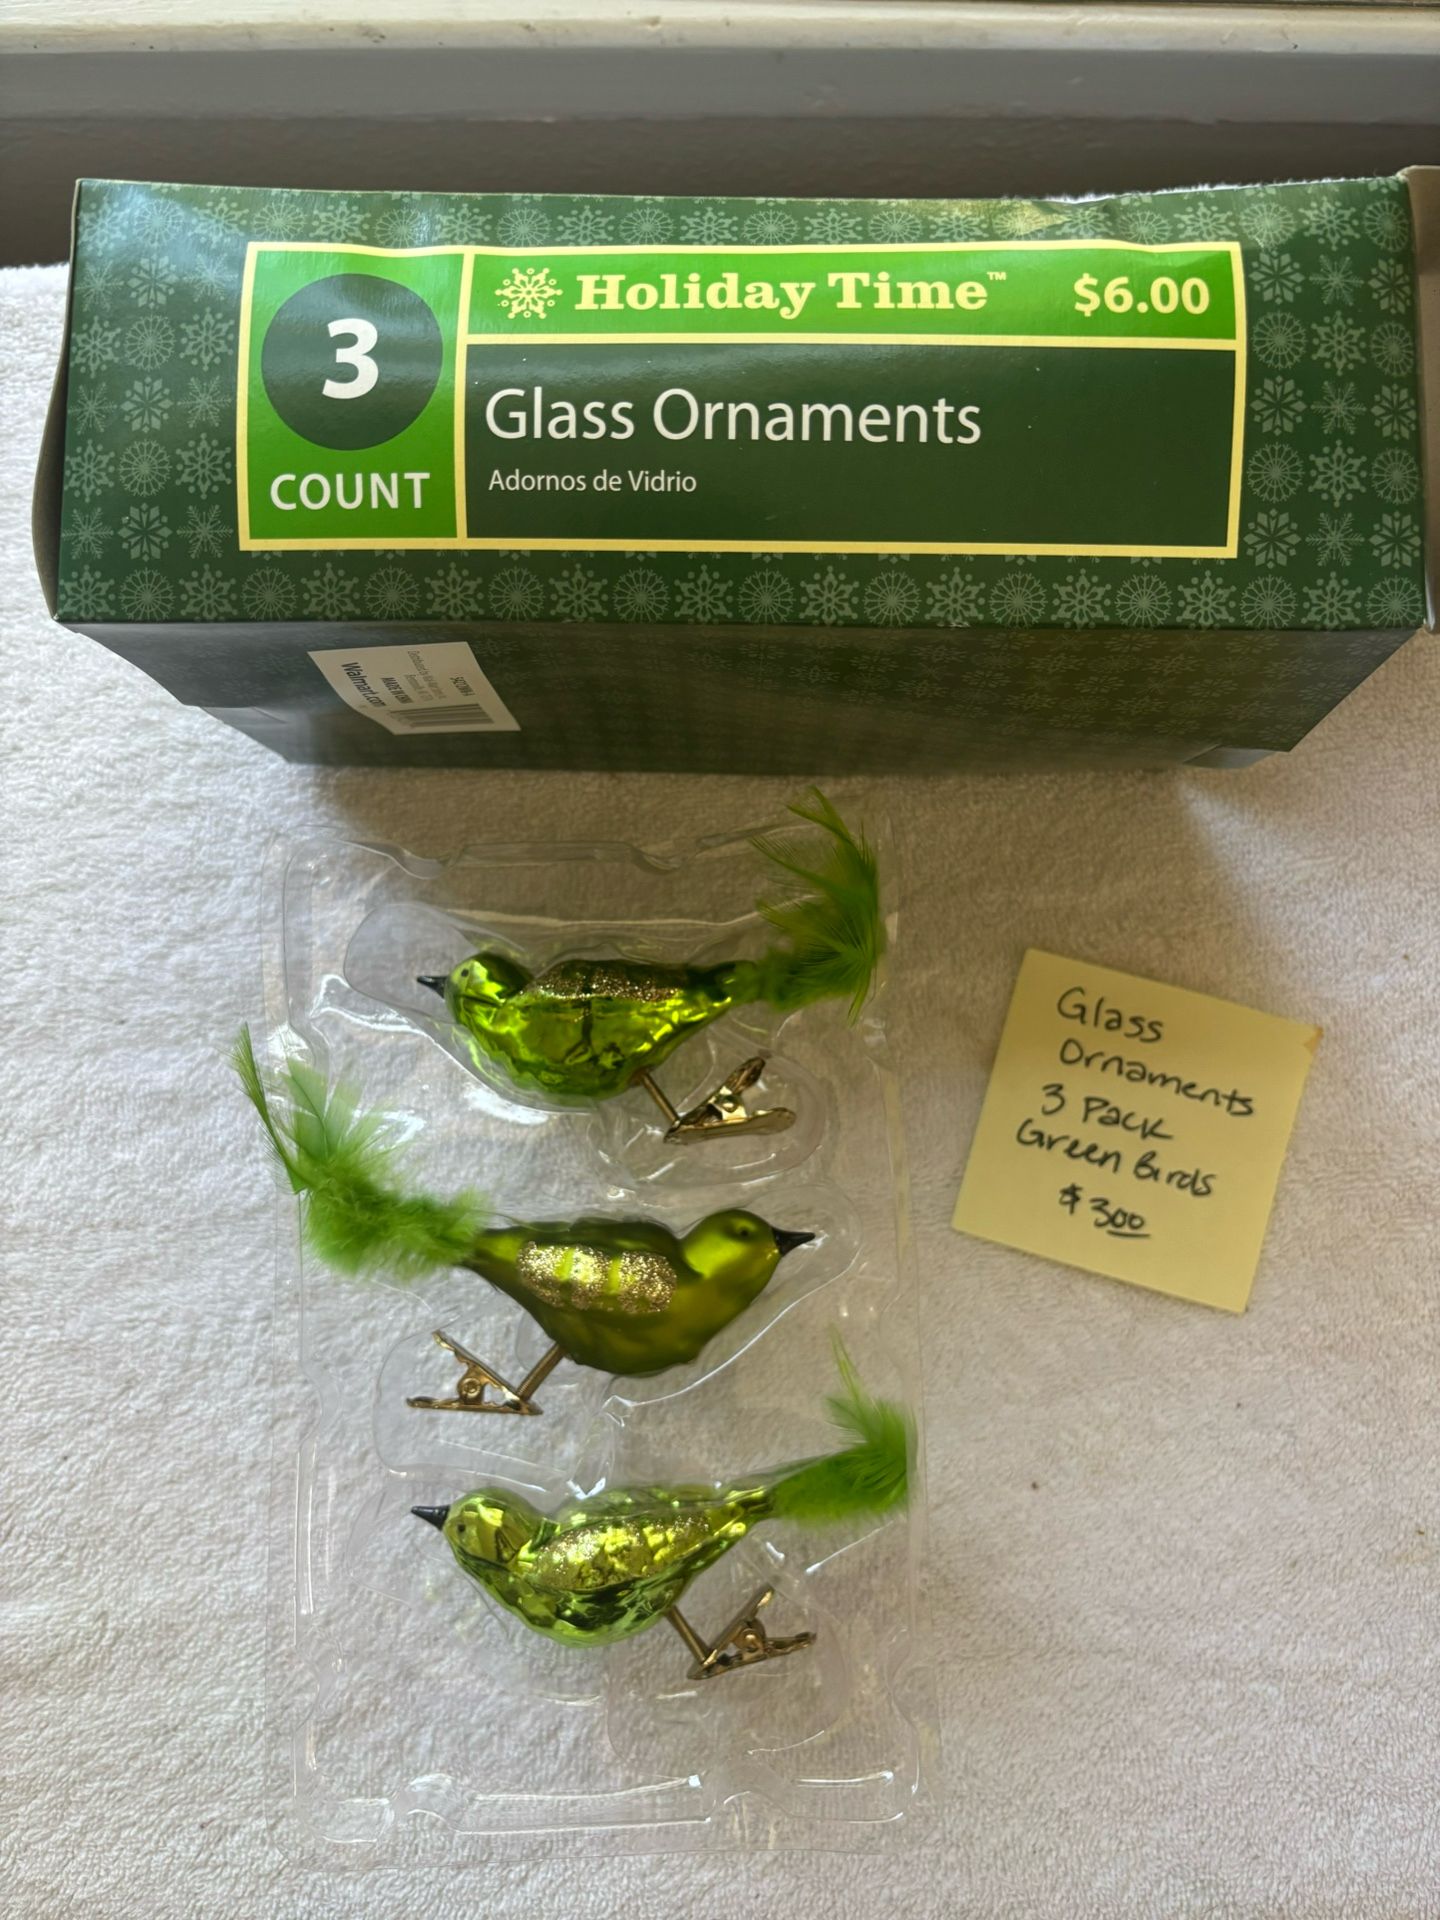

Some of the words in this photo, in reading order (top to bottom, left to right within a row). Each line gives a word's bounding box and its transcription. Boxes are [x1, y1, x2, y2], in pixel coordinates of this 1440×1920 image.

[574, 272, 816, 319] Holiday
[1073, 273, 1210, 317] $6.00
[321, 317, 379, 399] 3
[485, 386, 635, 441] Glass
[653, 387, 982, 444] Ornaments
[270, 472, 430, 511] COUNT
[488, 468, 587, 492] Adornos
[592, 468, 622, 492] de
[628, 469, 698, 493] Vidrio
[1056, 986, 1164, 1043] Glass
[1058, 1037, 1254, 1117] Ornaments
[1041, 1083, 1067, 1116] 3
[1081, 1096, 1174, 1140] Pack
[1015, 1119, 1122, 1174] Green
